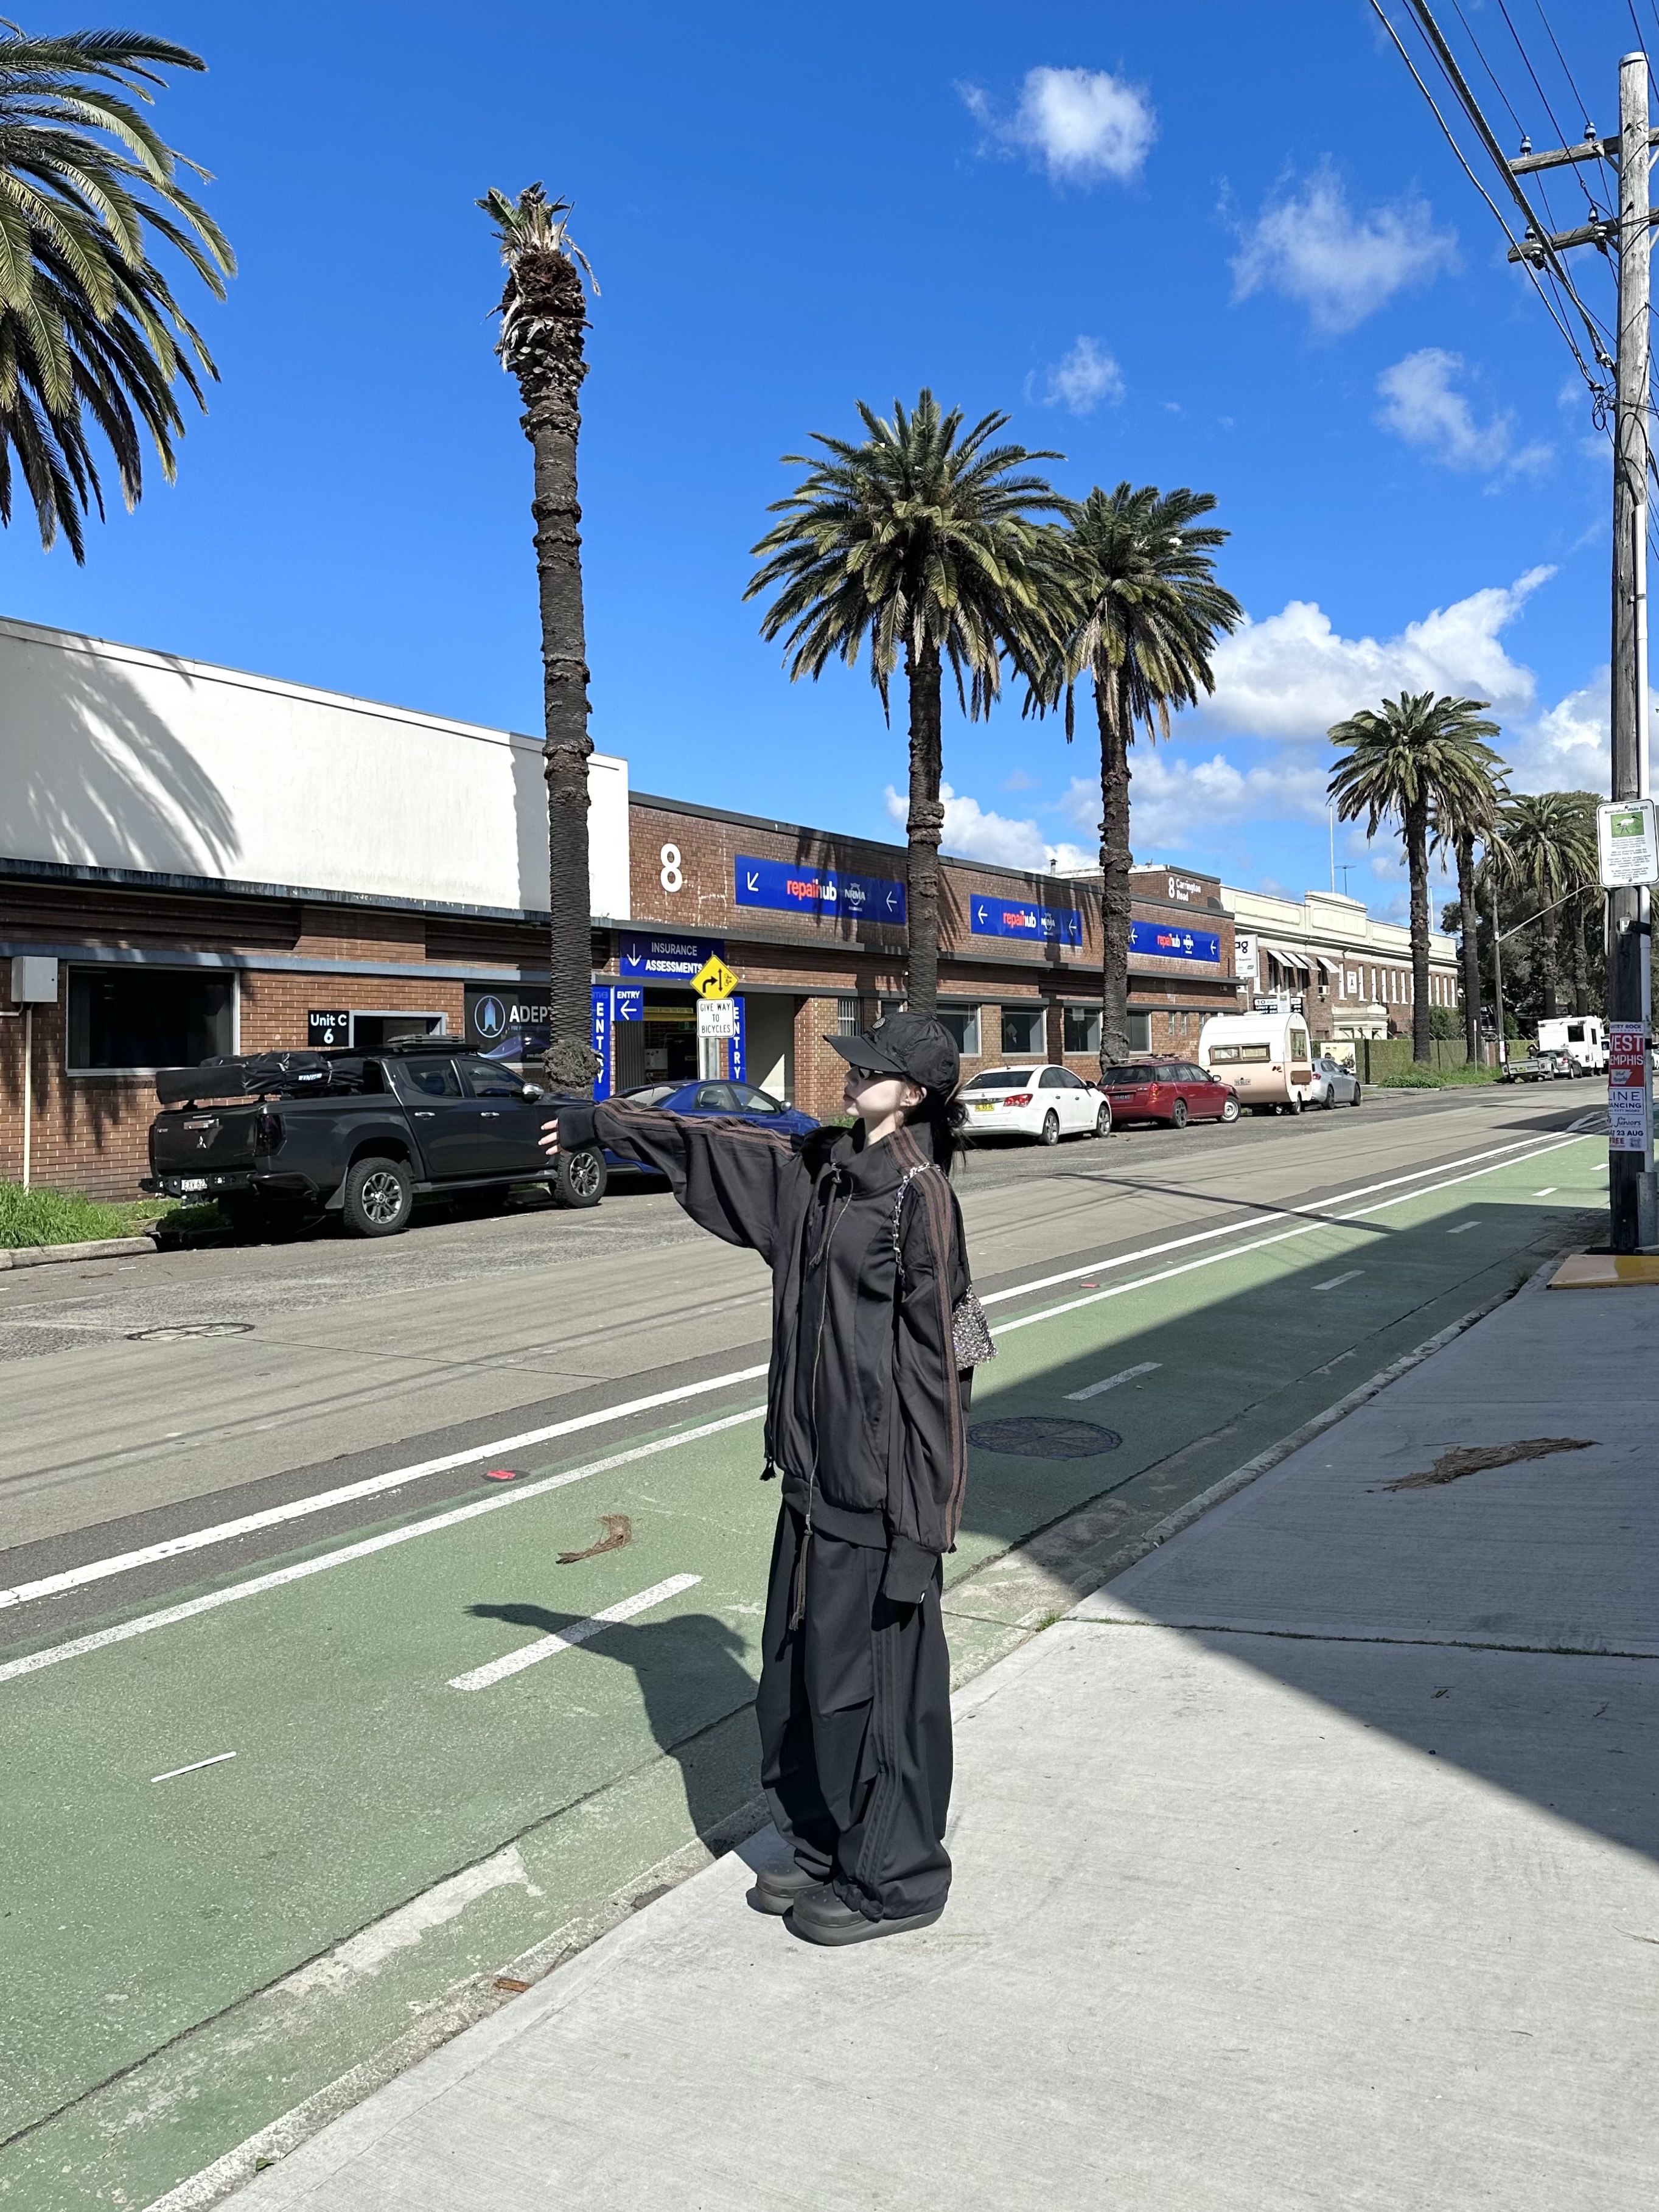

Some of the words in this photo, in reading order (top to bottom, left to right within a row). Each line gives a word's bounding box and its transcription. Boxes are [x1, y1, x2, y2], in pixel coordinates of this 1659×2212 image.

[660, 843, 683, 893] 8
[1168, 876, 1175, 898] 8
[1176, 878, 1201, 894] Carrington
[844, 888, 866, 901] NRMA
[1176, 890, 1189, 902] Road
[651, 941, 697, 957] INSURANCE
[645, 959, 703, 974] ASSESSMENTS
[616, 991, 640, 999] ENTRY
[700, 1003, 714, 1011] GIVE
[717, 1002, 730, 1011] WAY
[310, 1014, 335, 1026] Unit
[338, 1014, 347, 1026] C
[712, 1014, 719, 1022] TO
[702, 1025, 730, 1033] BICYCLES
[324, 1029, 334, 1044] 6
[596, 1002, 604, 1084] ENTRY
[1610, 1055, 1643, 1066] EMPHIS
[1613, 1117, 1641, 1128] Juniors
